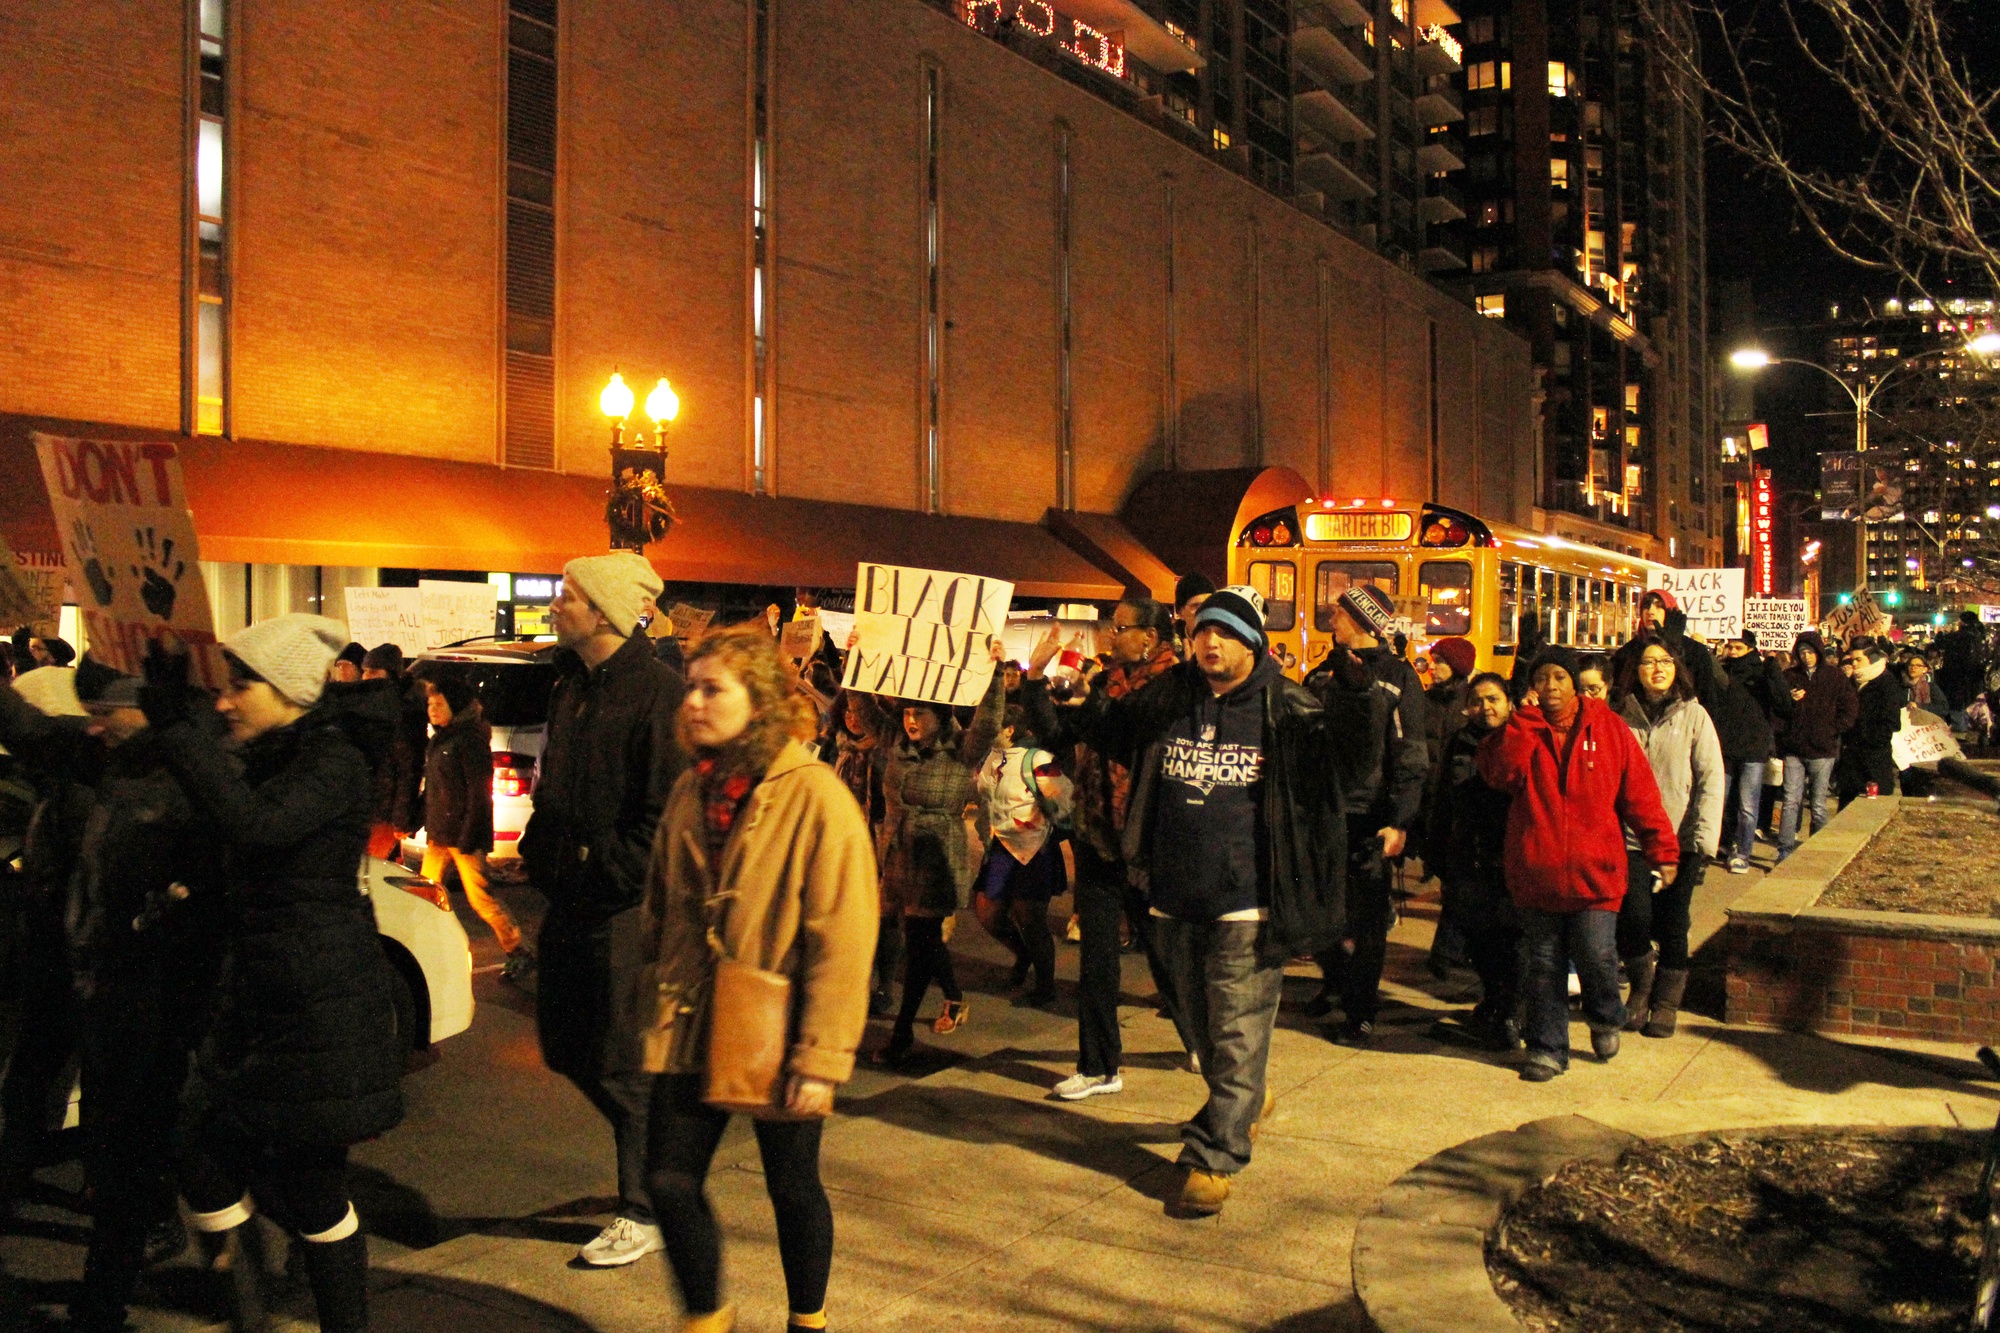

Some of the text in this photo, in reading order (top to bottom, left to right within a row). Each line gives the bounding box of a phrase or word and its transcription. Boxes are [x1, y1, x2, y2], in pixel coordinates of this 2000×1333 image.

[52, 440, 177, 506] DON'T
[1321, 514, 1376, 538] HARTER
[1662, 572, 1722, 592] BLACK
[864, 565, 1000, 631] BLACK
[1679, 594, 1727, 614] VES
[1762, 603, 1768, 612] I
[1770, 603, 1788, 612] LOVE
[1789, 603, 1804, 612] YOU
[398, 612, 420, 628] ALL
[1356, 595, 1389, 628] ENGLAN
[1384, 616, 1427, 642] EATHE
[1687, 616, 1737, 636] TTER
[1746, 622, 1790, 630] CONSCIOUS
[901, 618, 998, 676] LIVES
[1176, 738, 1194, 747] 2010
[1196, 742, 1214, 750] AFC
[1910, 735, 1938, 754] BLACK
[1916, 742, 1947, 762] POWER
[1163, 746, 1258, 765] DIVISION
[1162, 758, 1260, 782] HAMPIONS
